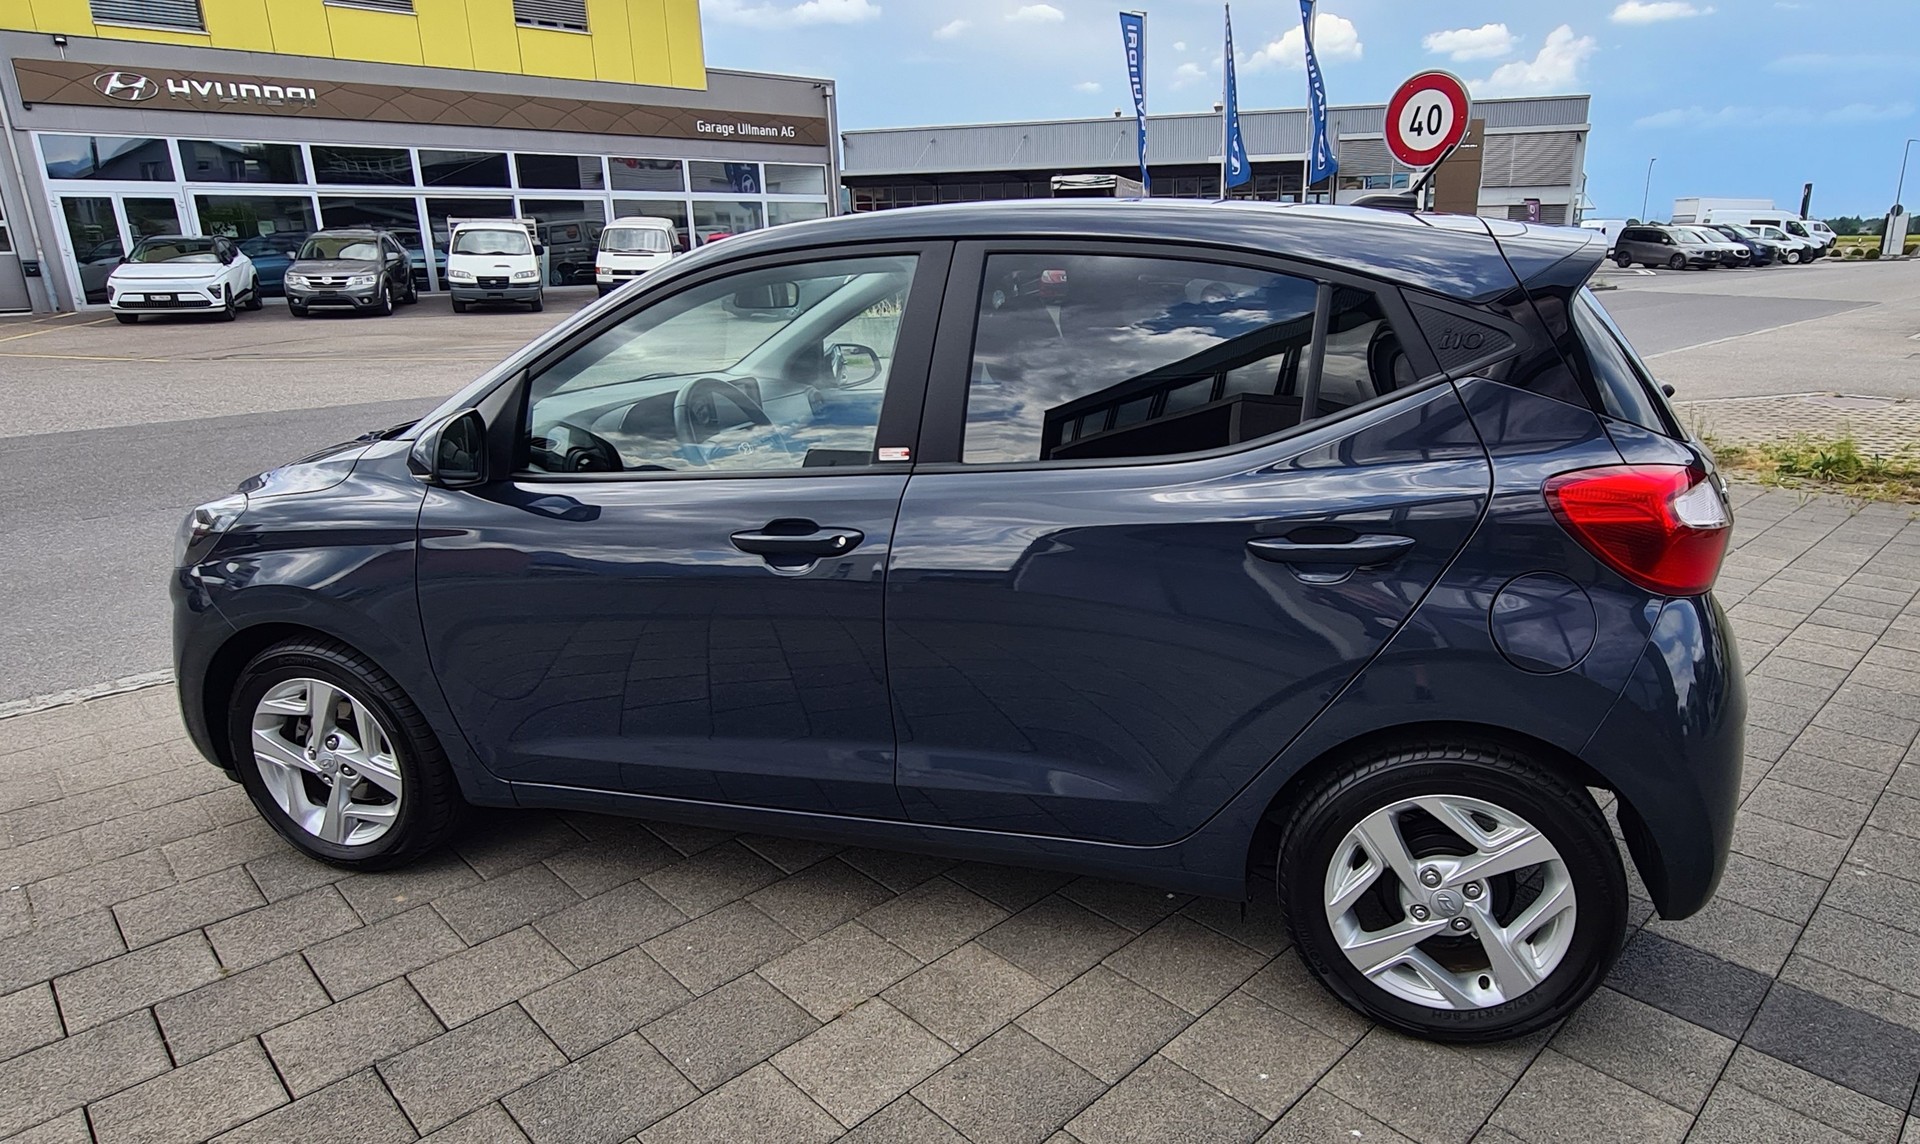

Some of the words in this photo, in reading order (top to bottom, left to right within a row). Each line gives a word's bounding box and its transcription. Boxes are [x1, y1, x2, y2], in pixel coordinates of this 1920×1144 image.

[166, 78, 317, 108] HYUNDAI
[696, 120, 735, 136] Garage
[737, 123, 778, 137] Ullmann
[780, 126, 796, 138] AG
[1409, 104, 1442, 136] 40
[1439, 327, 1485, 350] i10
